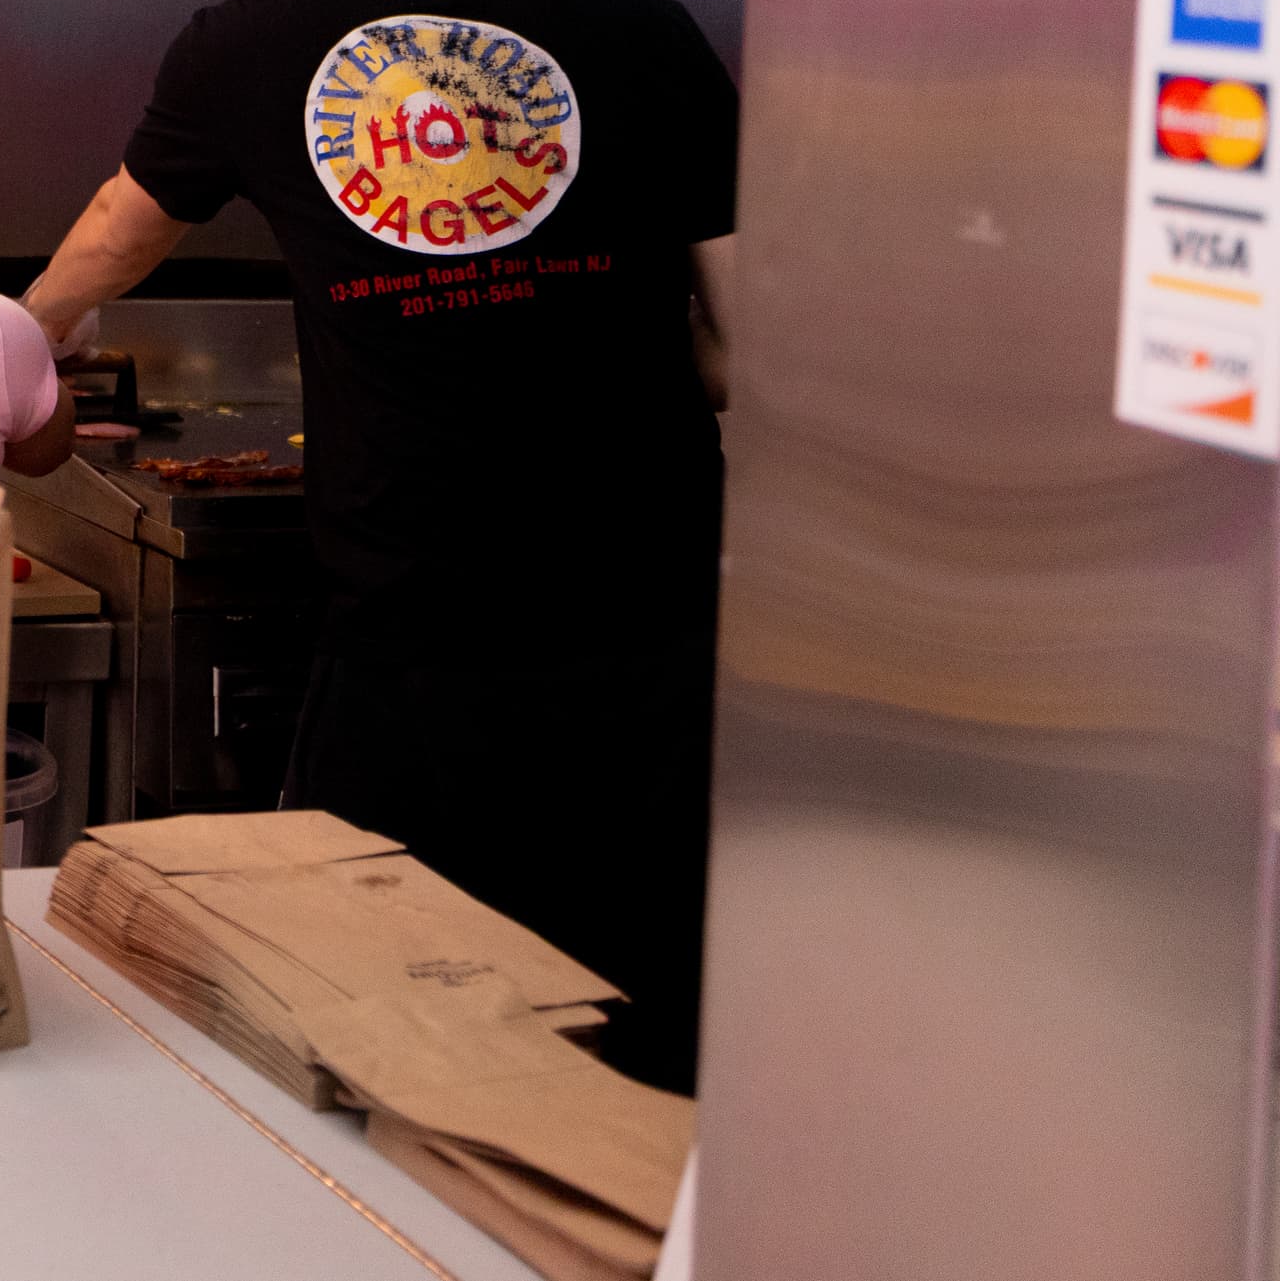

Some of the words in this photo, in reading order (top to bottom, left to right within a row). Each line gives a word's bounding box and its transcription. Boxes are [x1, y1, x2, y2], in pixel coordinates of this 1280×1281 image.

[313, 23, 426, 167] RIVER
[338, 137, 568, 246] BAGELS
[330, 277, 371, 303] 13-30
[374, 273, 421, 295] River
[491, 258, 529, 278] Fair
[536, 256, 579, 274] Lawn
[587, 255, 611, 272] NJ
[1164, 224, 1251, 273] VISA
